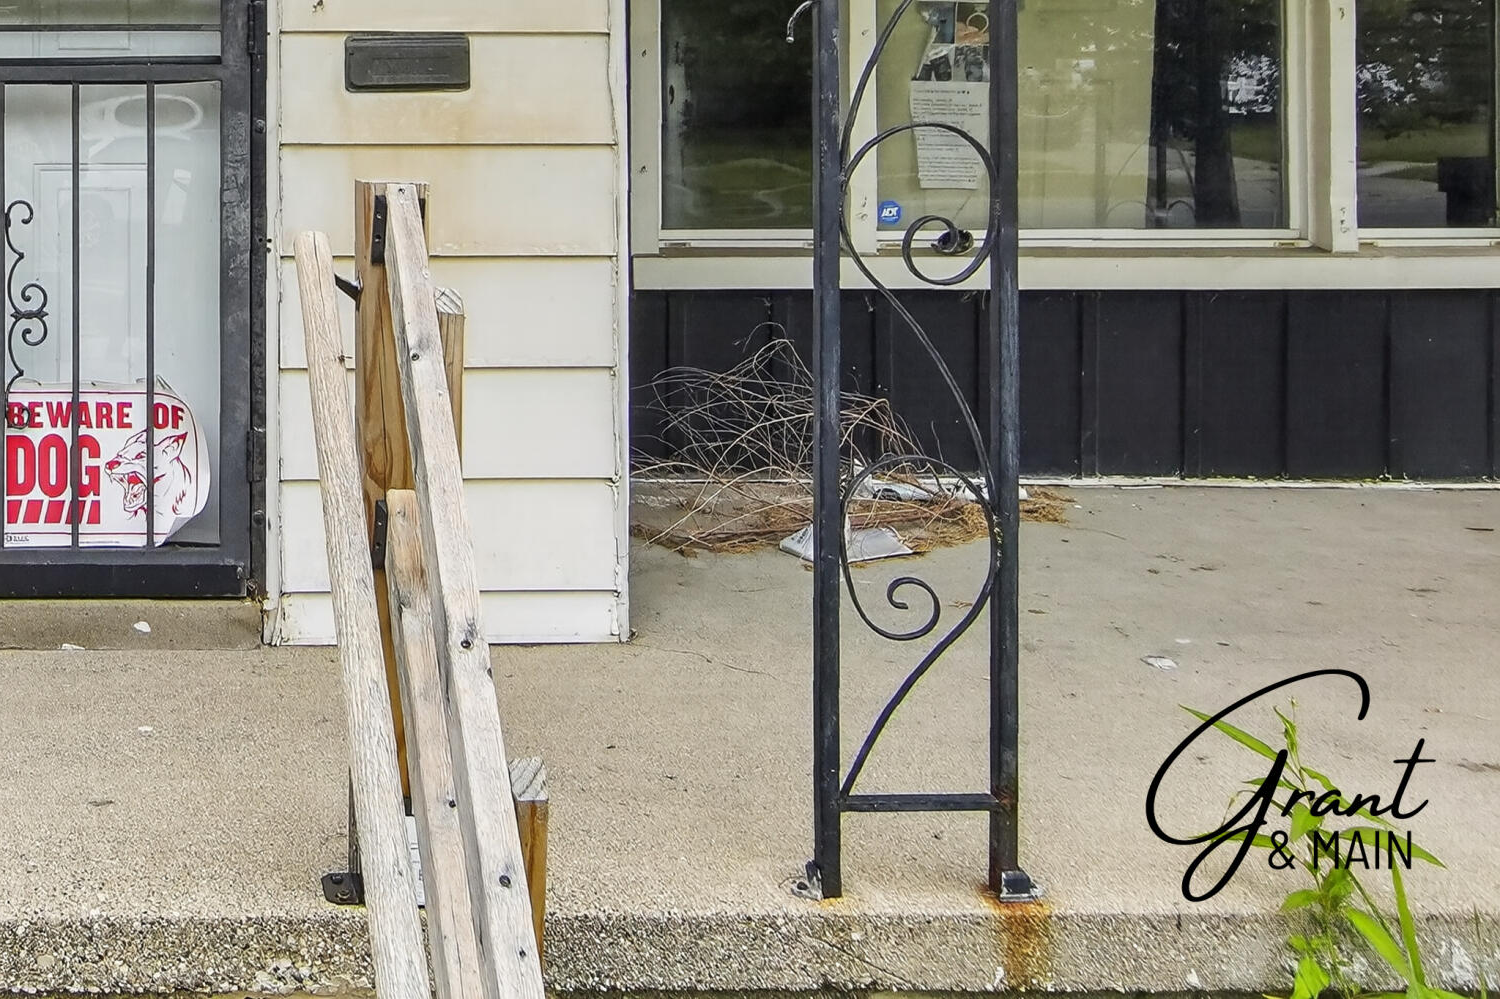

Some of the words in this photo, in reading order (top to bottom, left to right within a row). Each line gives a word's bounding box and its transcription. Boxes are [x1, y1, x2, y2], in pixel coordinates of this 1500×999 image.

[881, 207, 898, 217] ADT
[6, 401, 132, 429] BEWARE
[152, 402, 185, 429] OF
[6, 433, 100, 498] DOG
